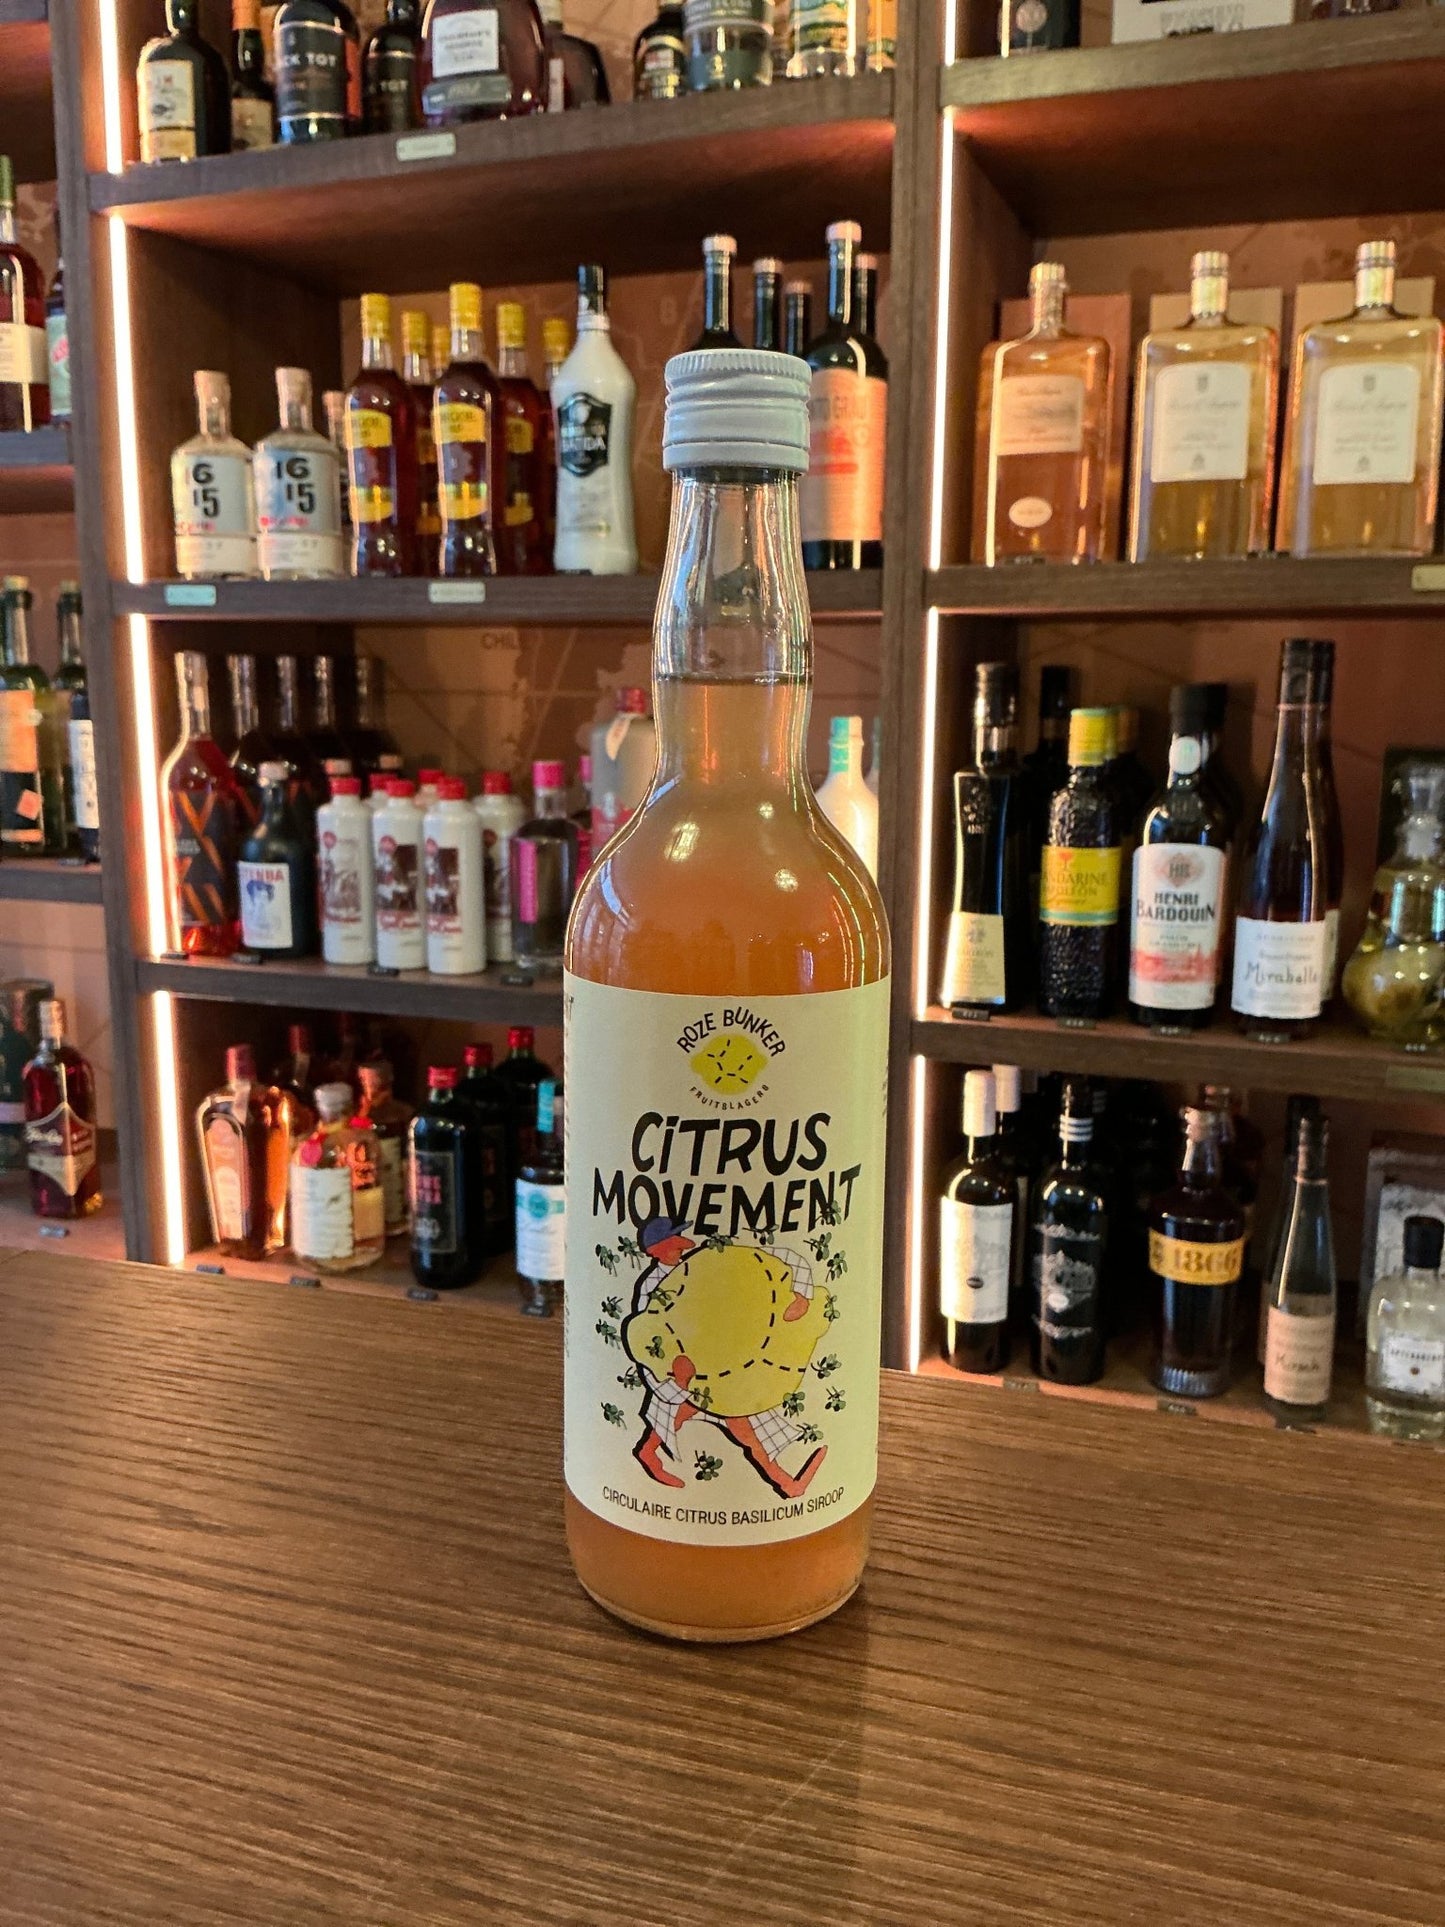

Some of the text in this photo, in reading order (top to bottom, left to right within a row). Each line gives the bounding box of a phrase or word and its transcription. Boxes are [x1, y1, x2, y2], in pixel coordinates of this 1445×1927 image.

[276, 457, 310, 480] 16
[286, 483, 316, 514] 15
[1137, 899, 1216, 923] BARDOUIN
[1153, 891, 1200, 905] HENRI
[676, 1006, 786, 1057] ROZE BUNKER
[592, 1163, 862, 1237] MOVEMENT
[602, 1486, 846, 1526] CIRCULAIRE CITRUS BASILICUM SIROOP
